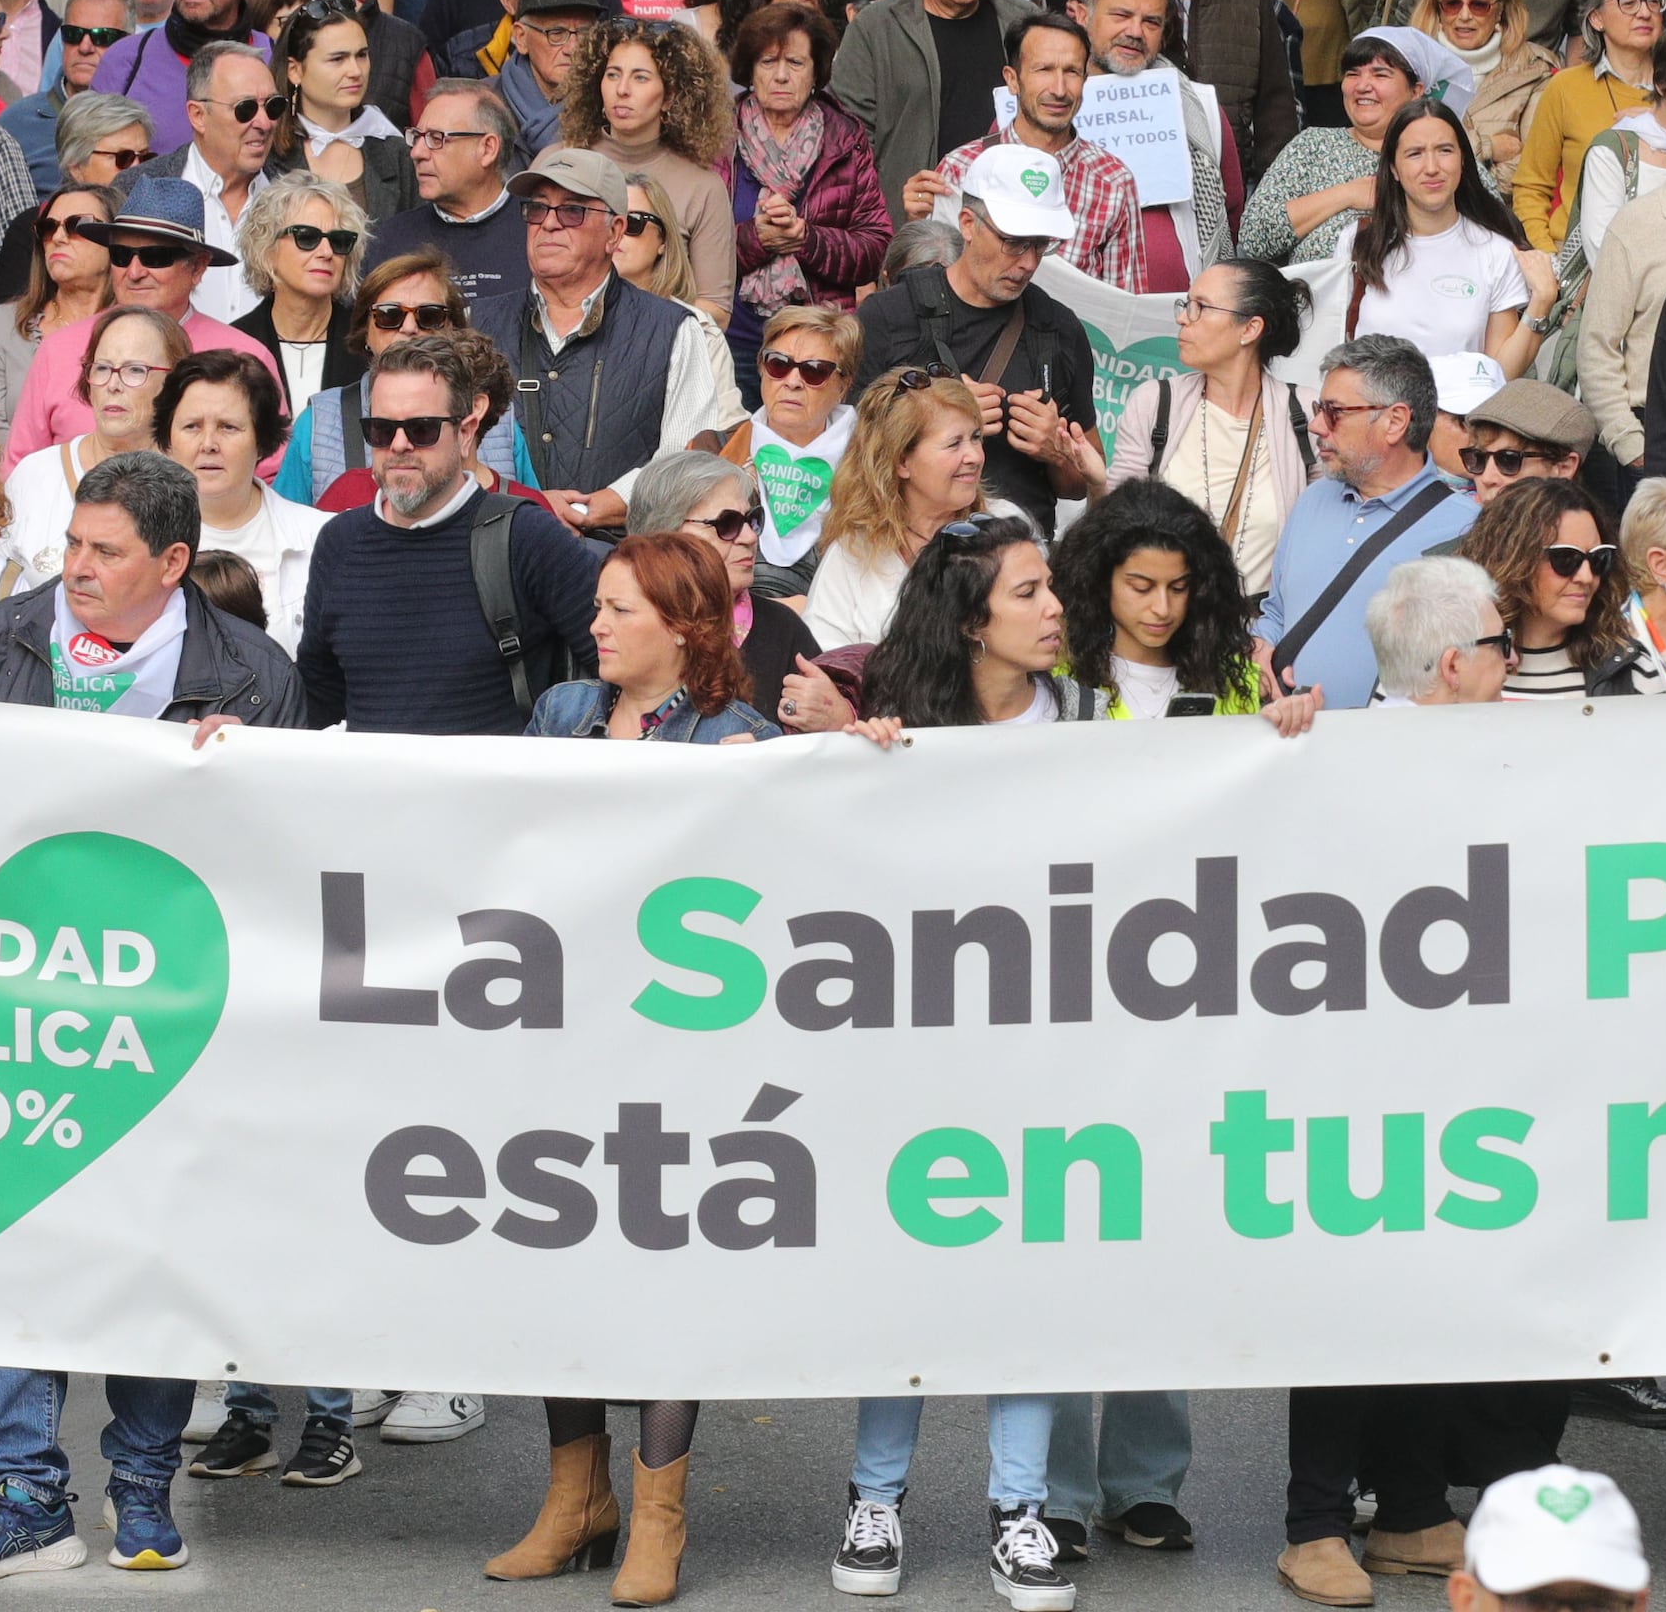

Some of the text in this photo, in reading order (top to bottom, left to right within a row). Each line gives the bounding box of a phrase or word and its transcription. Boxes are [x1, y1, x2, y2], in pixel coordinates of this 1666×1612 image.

[1096, 83, 1172, 104] PÚBLICA
[1076, 109, 1155, 129] IVERSAL,
[1111, 136, 1121, 148] Y
[1127, 129, 1178, 146] TODOS
[760, 461, 823, 490] SANIDAD
[773, 501, 807, 517] 00%
[72, 636, 117, 663] UGT
[318, 870, 564, 1032] La
[630, 843, 1512, 1033] Sanidad
[364, 1082, 818, 1252] está
[886, 1122, 1144, 1249] en
[1209, 1089, 1540, 1241] tus
